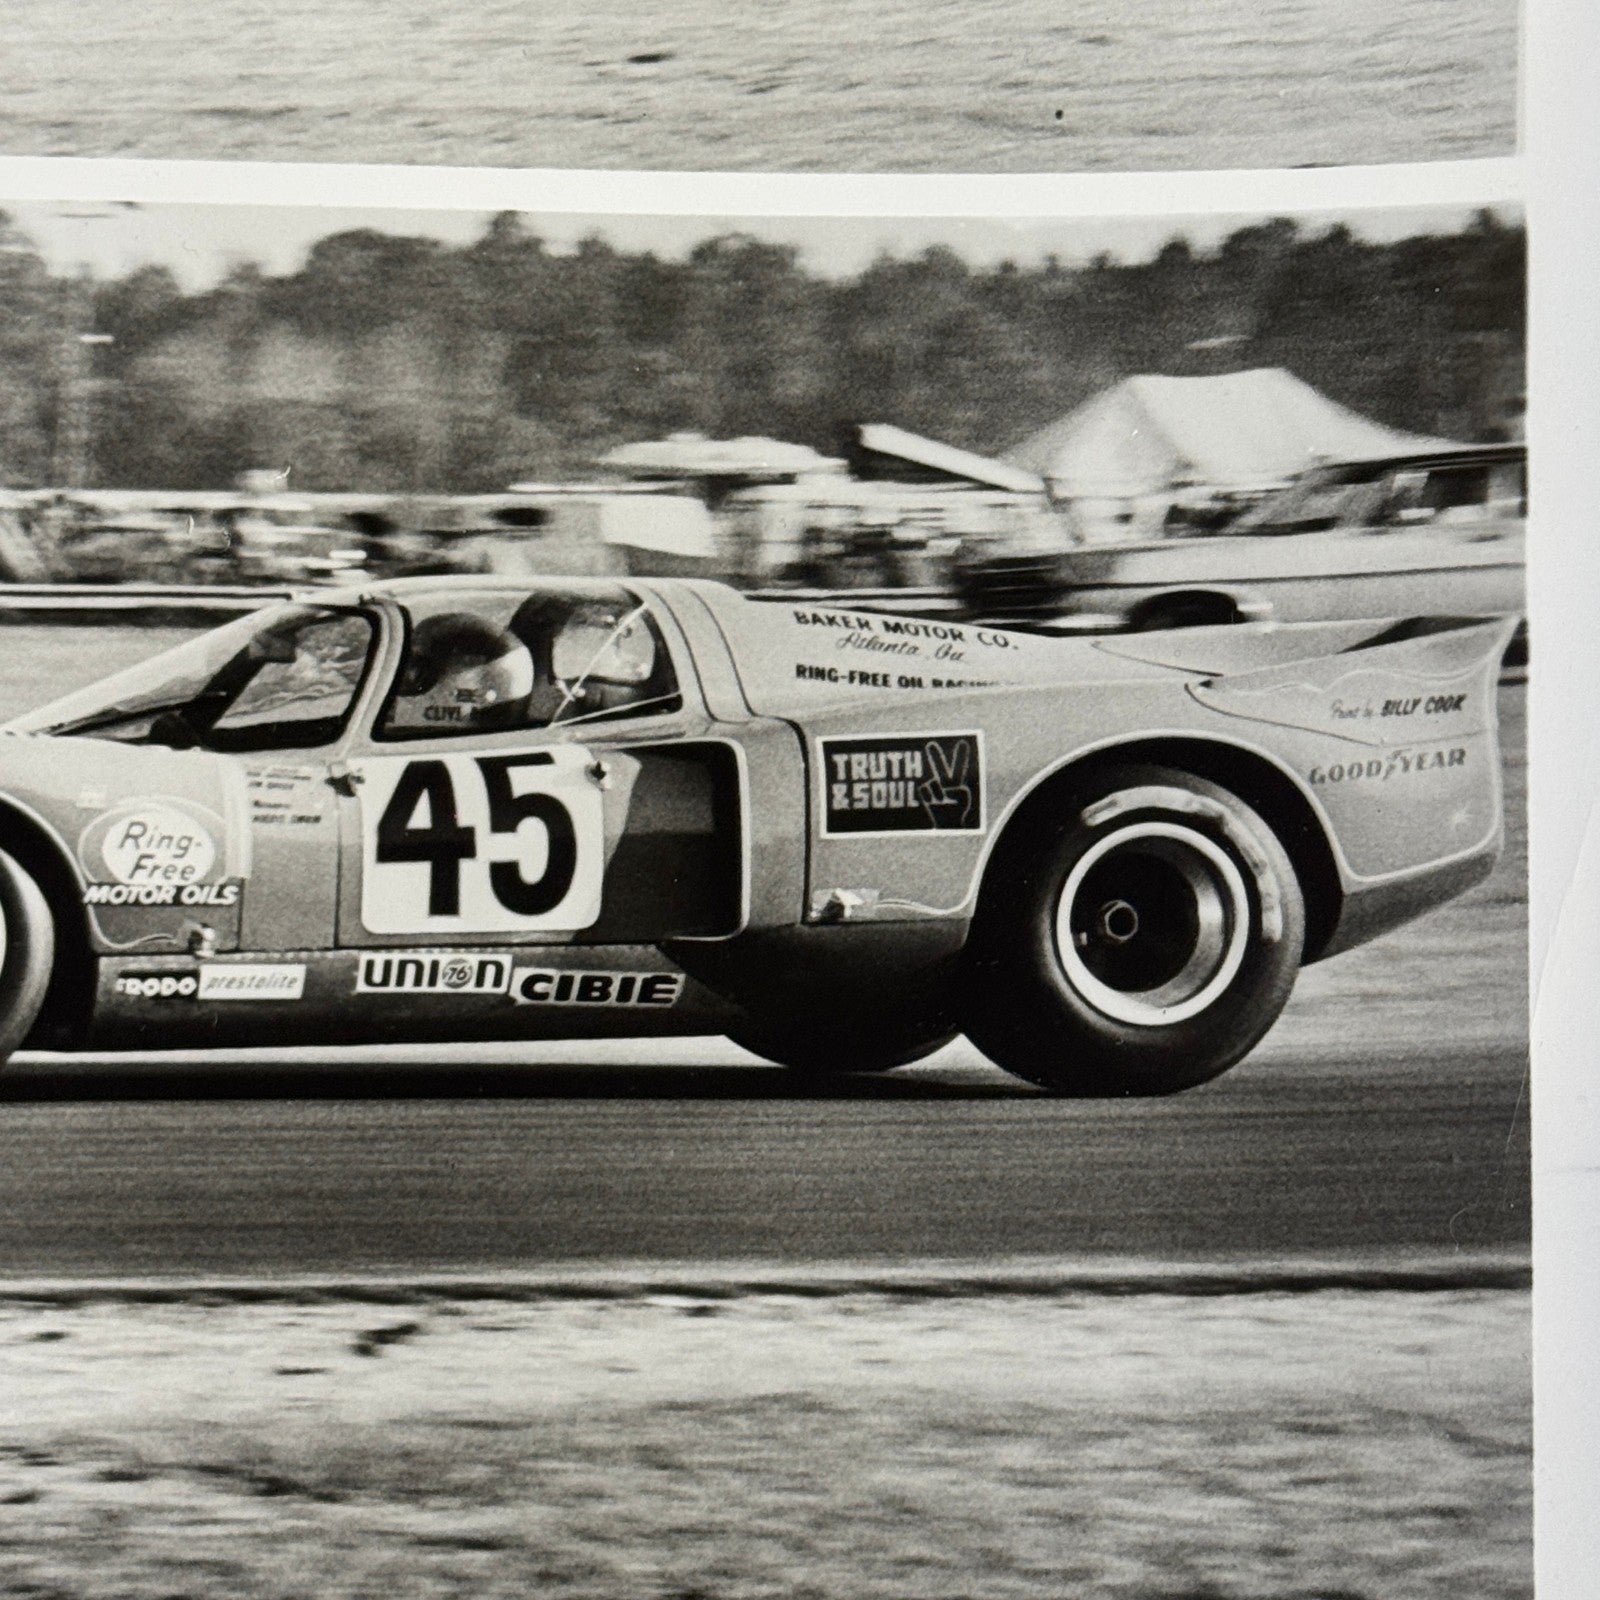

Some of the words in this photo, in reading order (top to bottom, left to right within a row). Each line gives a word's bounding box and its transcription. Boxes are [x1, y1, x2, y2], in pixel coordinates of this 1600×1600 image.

[793, 611, 871, 632] BAKER
[882, 620, 965, 643] MOTOR
[976, 632, 1020, 650] CO.
[795, 664, 891, 688] RING-FREE
[897, 674, 923, 689] OIL
[932, 678, 1000, 688] RAC
[1380, 697, 1422, 717] BILLY
[1424, 693, 1468, 714] COOK
[831, 750, 923, 780] TRUTH
[1308, 748, 1467, 786] GOODYEAR
[119, 821, 204, 858] Ring-
[376, 751, 577, 917] 45
[128, 853, 197, 882] Free
[83, 884, 175, 906] MOTOR
[180, 884, 241, 906] OILS
[204, 971, 299, 991] prestolite
[448, 965, 468, 982] 76
